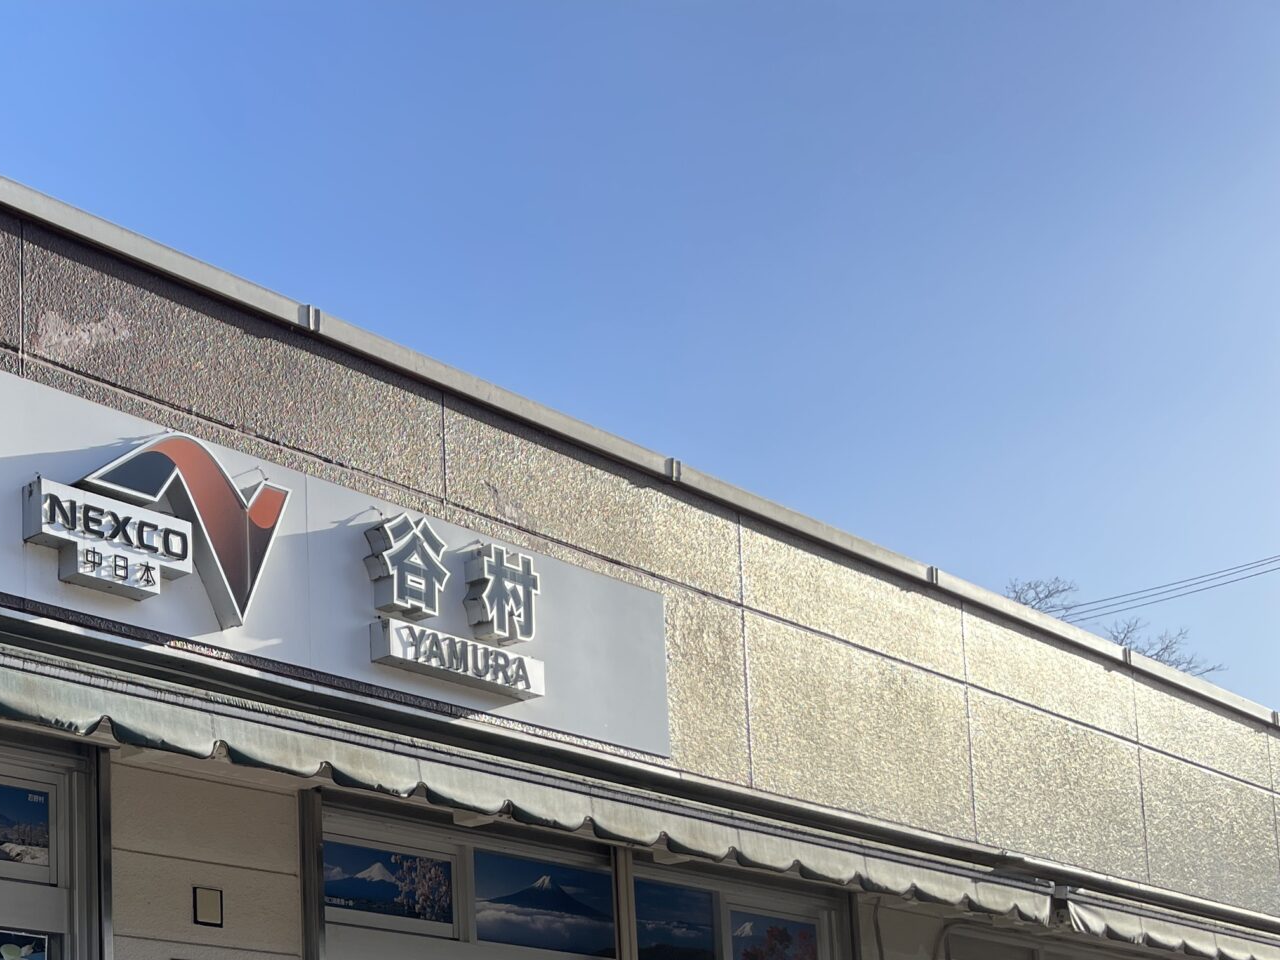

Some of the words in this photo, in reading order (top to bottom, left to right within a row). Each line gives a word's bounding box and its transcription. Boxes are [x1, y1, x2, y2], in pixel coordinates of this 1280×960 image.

[47, 494, 189, 560] NEXCO
[84, 546, 156, 586] 中日本
[382, 512, 541, 642] 谷村
[404, 625, 531, 690] YAMURA
